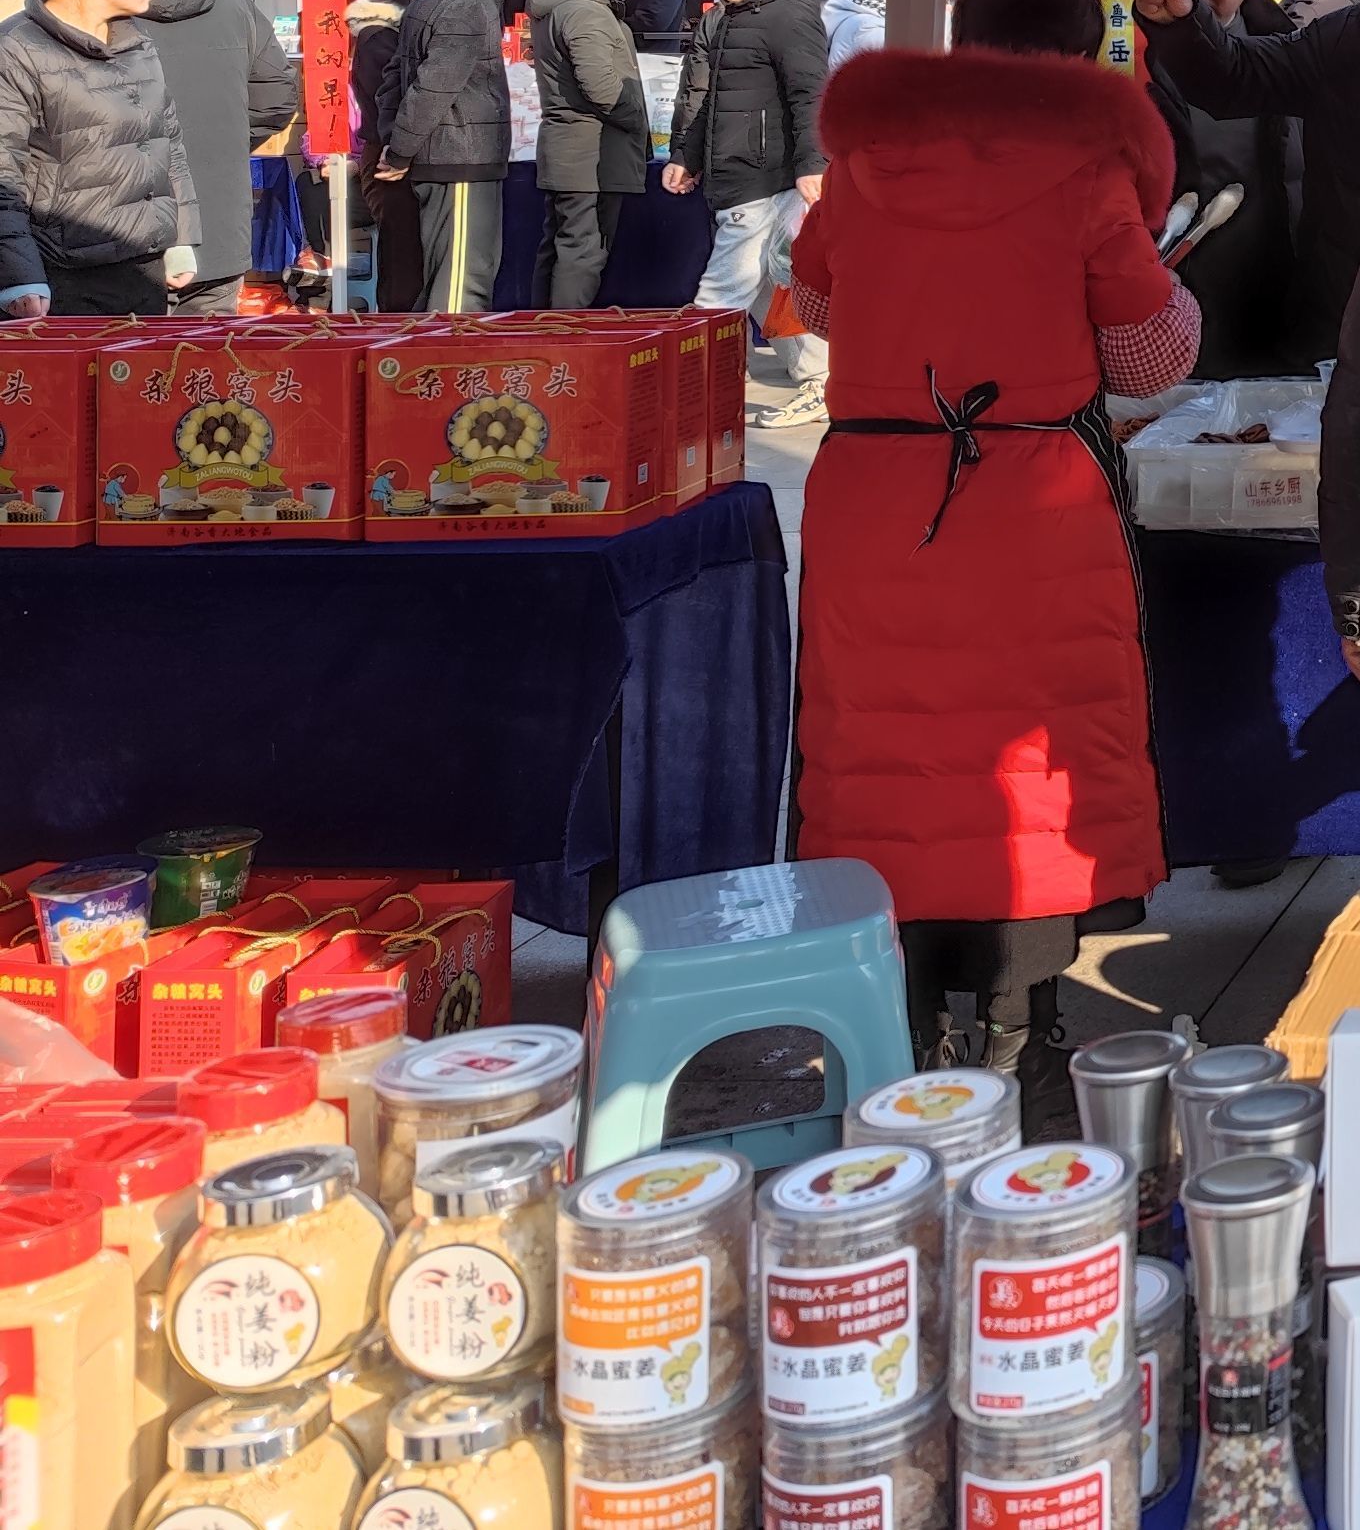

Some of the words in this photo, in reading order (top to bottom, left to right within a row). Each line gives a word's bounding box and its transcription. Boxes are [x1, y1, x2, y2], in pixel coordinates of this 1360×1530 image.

[139, 366, 303, 406] 杂粮窝头
[414, 362, 578, 401] 杂粮窝头
[1245, 476, 1301, 498] 山东乡厨
[151, 982, 224, 1001] 杂粮窝头
[573, 1357, 657, 1381] 水晶蜜姜
[782, 1352, 867, 1380] 水晶蜜姜
[997, 1339, 1086, 1373] 水晶蜜姜
